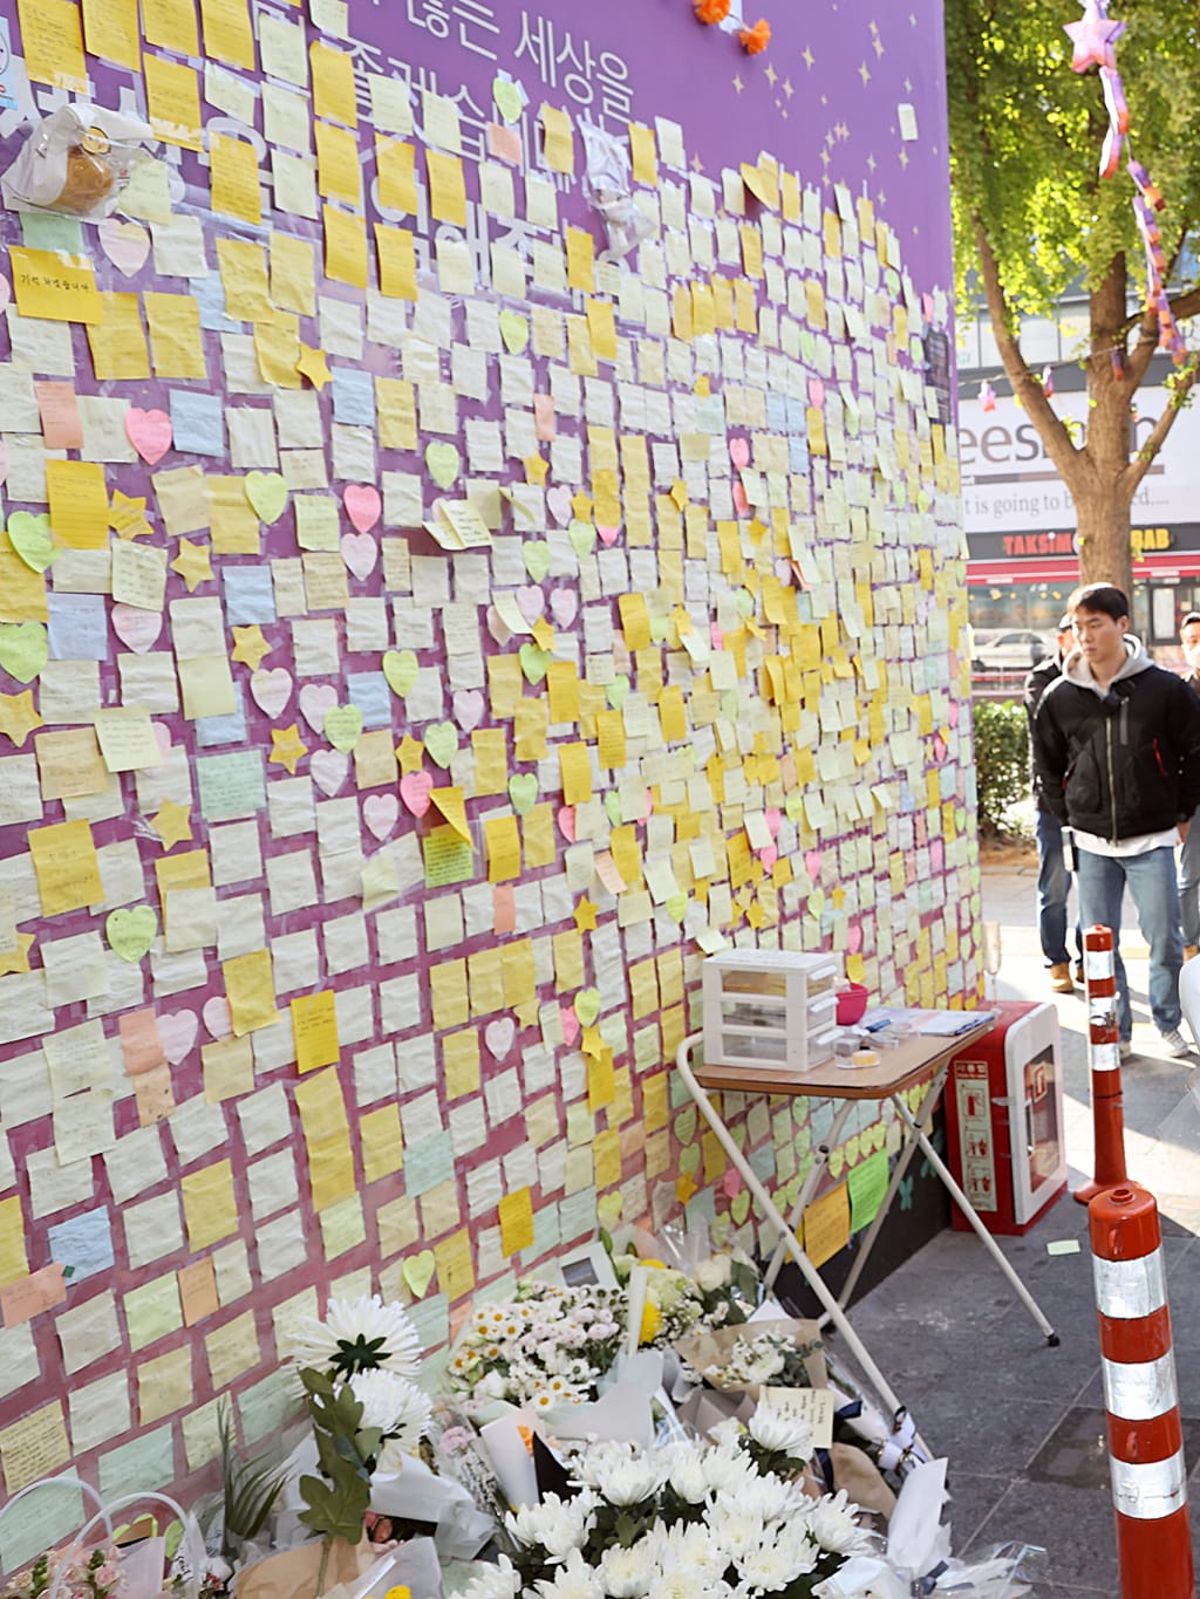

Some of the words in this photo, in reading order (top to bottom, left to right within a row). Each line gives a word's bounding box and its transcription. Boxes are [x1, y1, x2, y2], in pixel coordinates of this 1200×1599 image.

[515, 11, 634, 123] 세상을
[993, 492, 1041, 519] going
[1043, 493, 1061, 510] to
